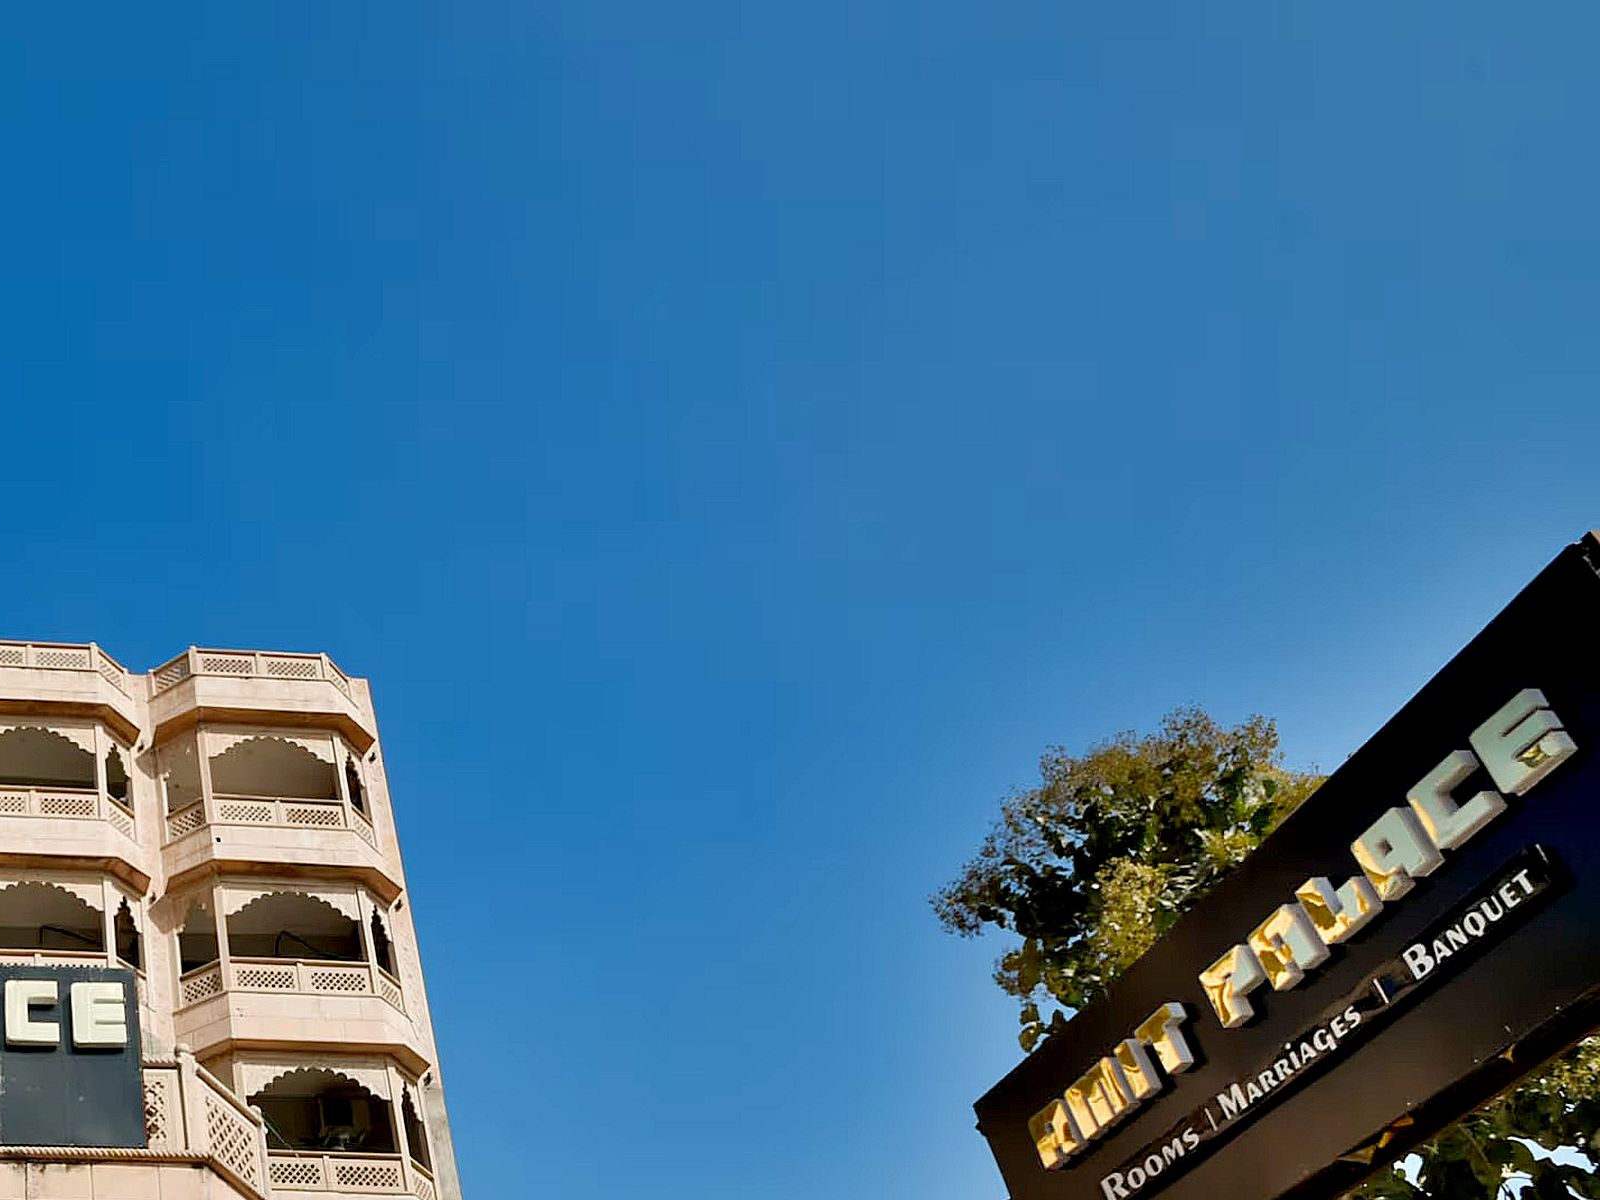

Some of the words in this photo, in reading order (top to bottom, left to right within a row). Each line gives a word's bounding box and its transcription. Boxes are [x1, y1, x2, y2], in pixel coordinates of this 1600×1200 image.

[1027, 1001, 1195, 1171] AMIT
[1198, 687, 1579, 1029] PALACE
[1402, 867, 1537, 981] BANQUET
